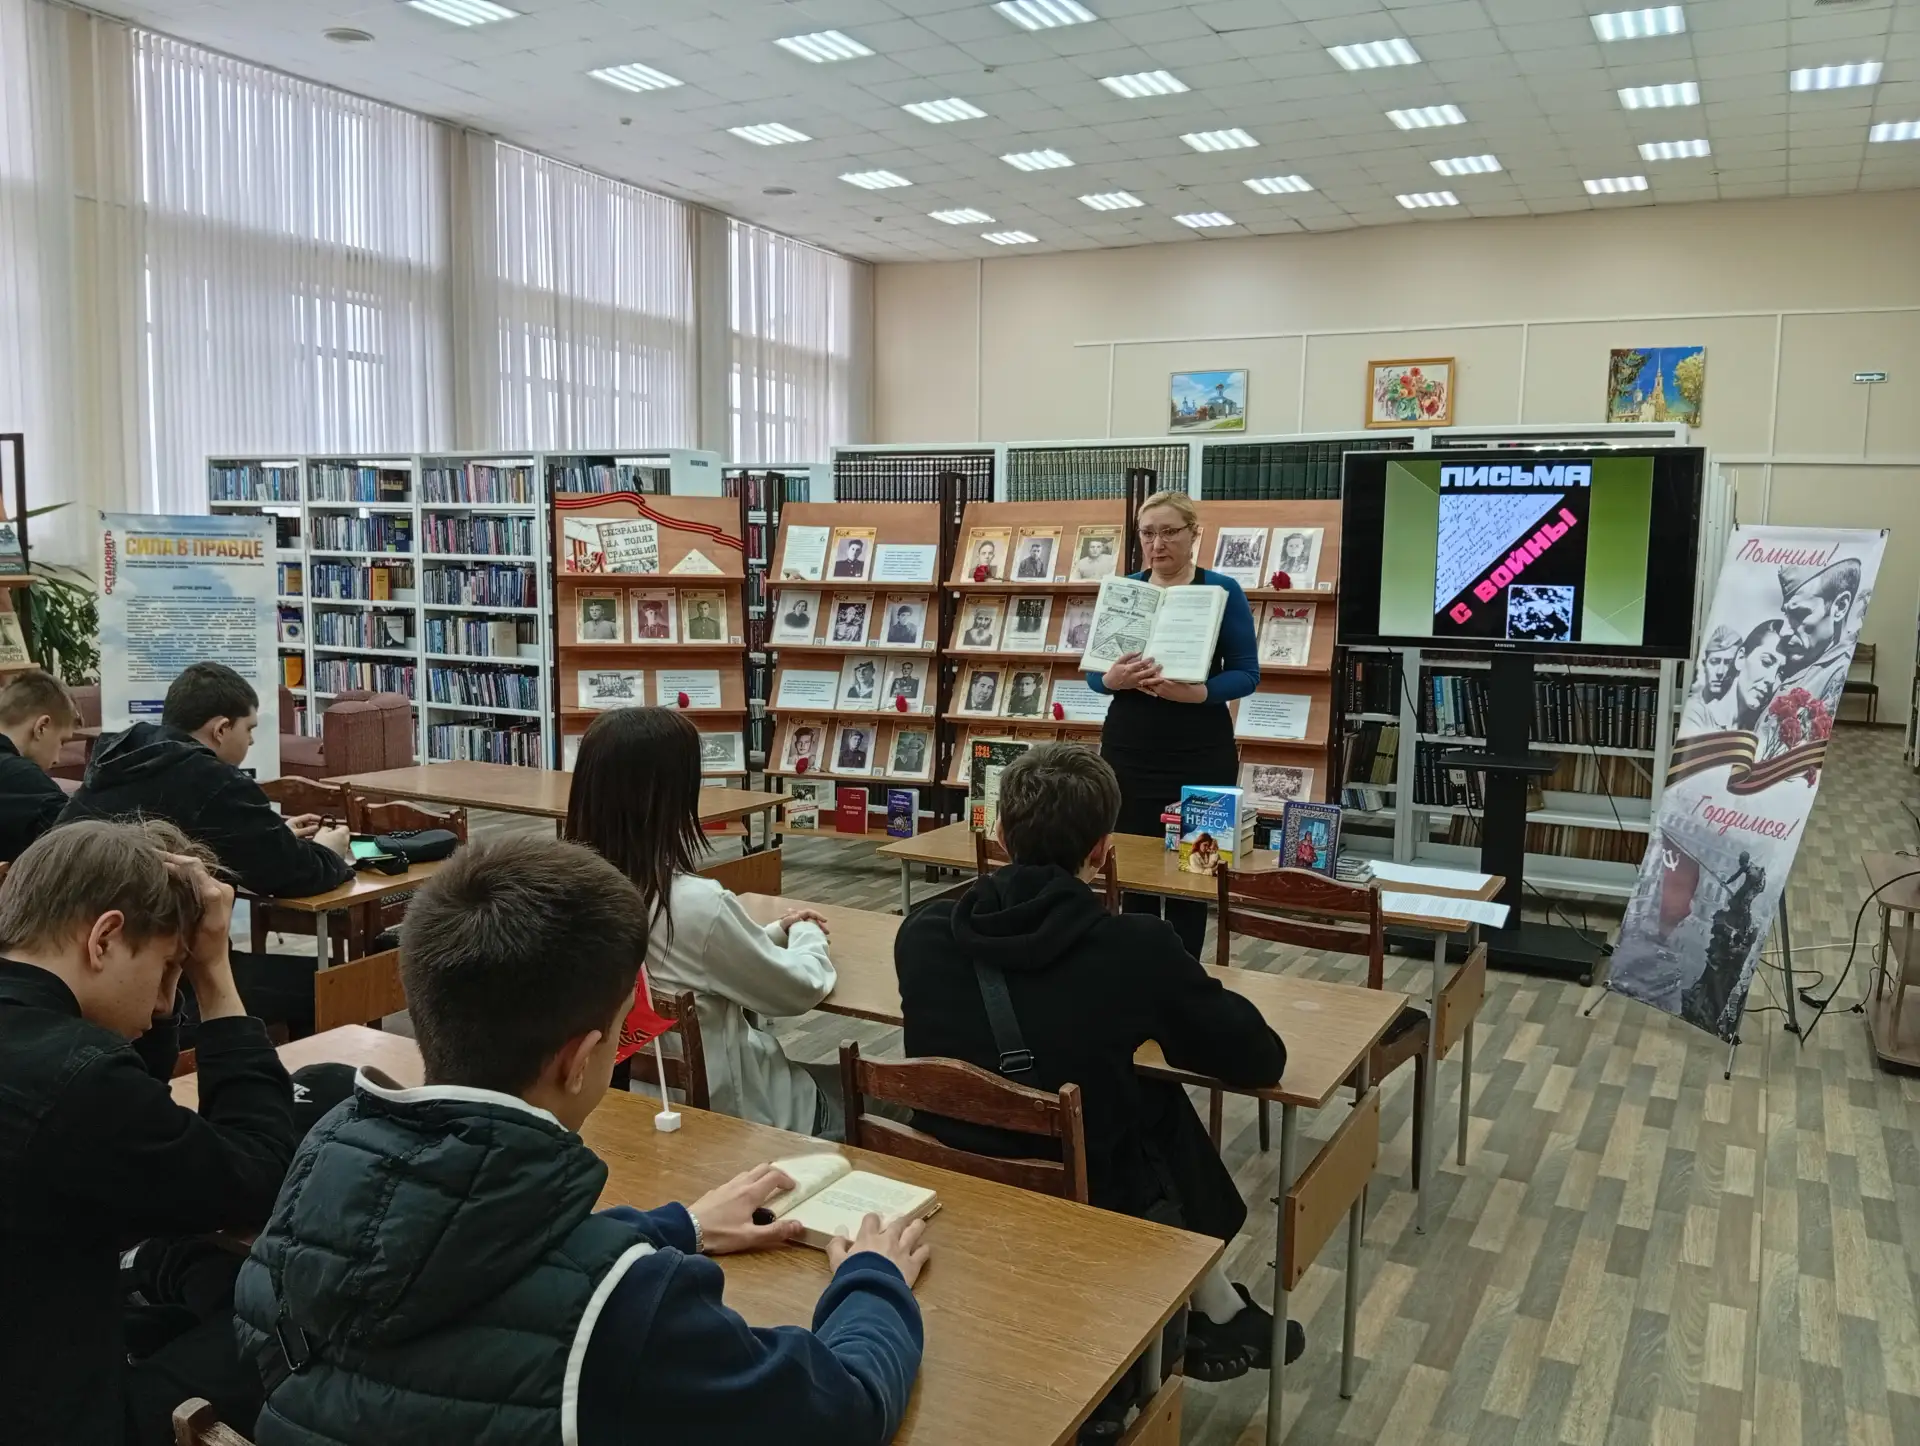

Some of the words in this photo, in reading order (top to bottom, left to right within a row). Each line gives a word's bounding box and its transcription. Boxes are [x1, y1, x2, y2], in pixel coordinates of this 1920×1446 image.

[1440, 465, 1592, 487] ПИСЬМА
[602, 524, 654, 538] СЫЗРАНЦЫ
[606, 540, 619, 549] НА
[625, 535, 654, 546] ПОЛЯХ
[125, 537, 173, 557] СИЛА
[177, 539, 188, 556] В
[193, 539, 264, 559] ПРАВДЕ
[607, 544, 657, 559] СРАЖЕНИЙ
[1473, 507, 1578, 603] ВОЙНЫ
[1736, 538, 1840, 567] Помним!
[104, 530, 112, 596] ОСТАНОВИТЬ
[1186, 814, 1229, 829] НЕБЕСА
[1208, 810, 1229, 818] СКАЖУТ
[1691, 795, 1800, 841] Гордимся!
